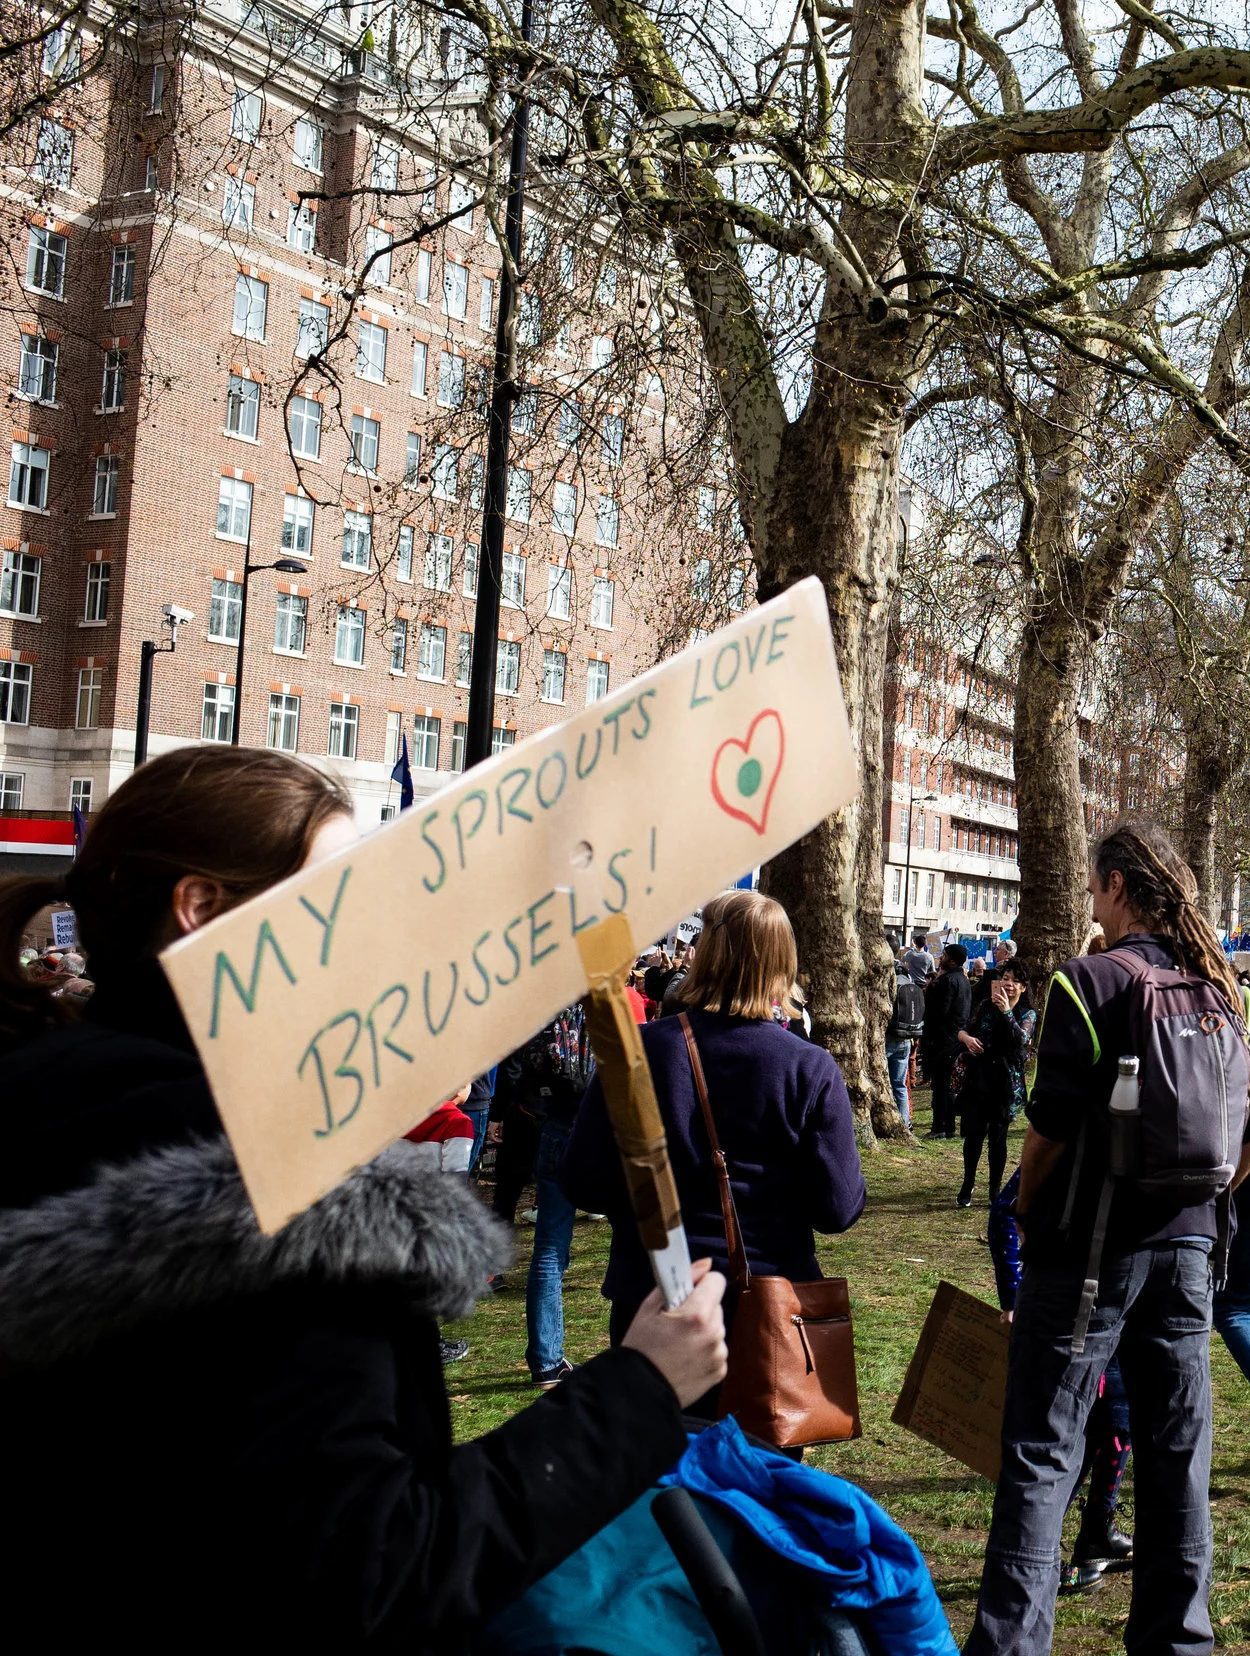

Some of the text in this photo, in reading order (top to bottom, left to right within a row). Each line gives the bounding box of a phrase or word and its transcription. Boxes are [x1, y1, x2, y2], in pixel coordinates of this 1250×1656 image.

[56, 924, 73, 933] Rema
[207, 615, 797, 1040] MY SPROUTS LOVE
[296, 827, 659, 1140] BRUSSELS!
